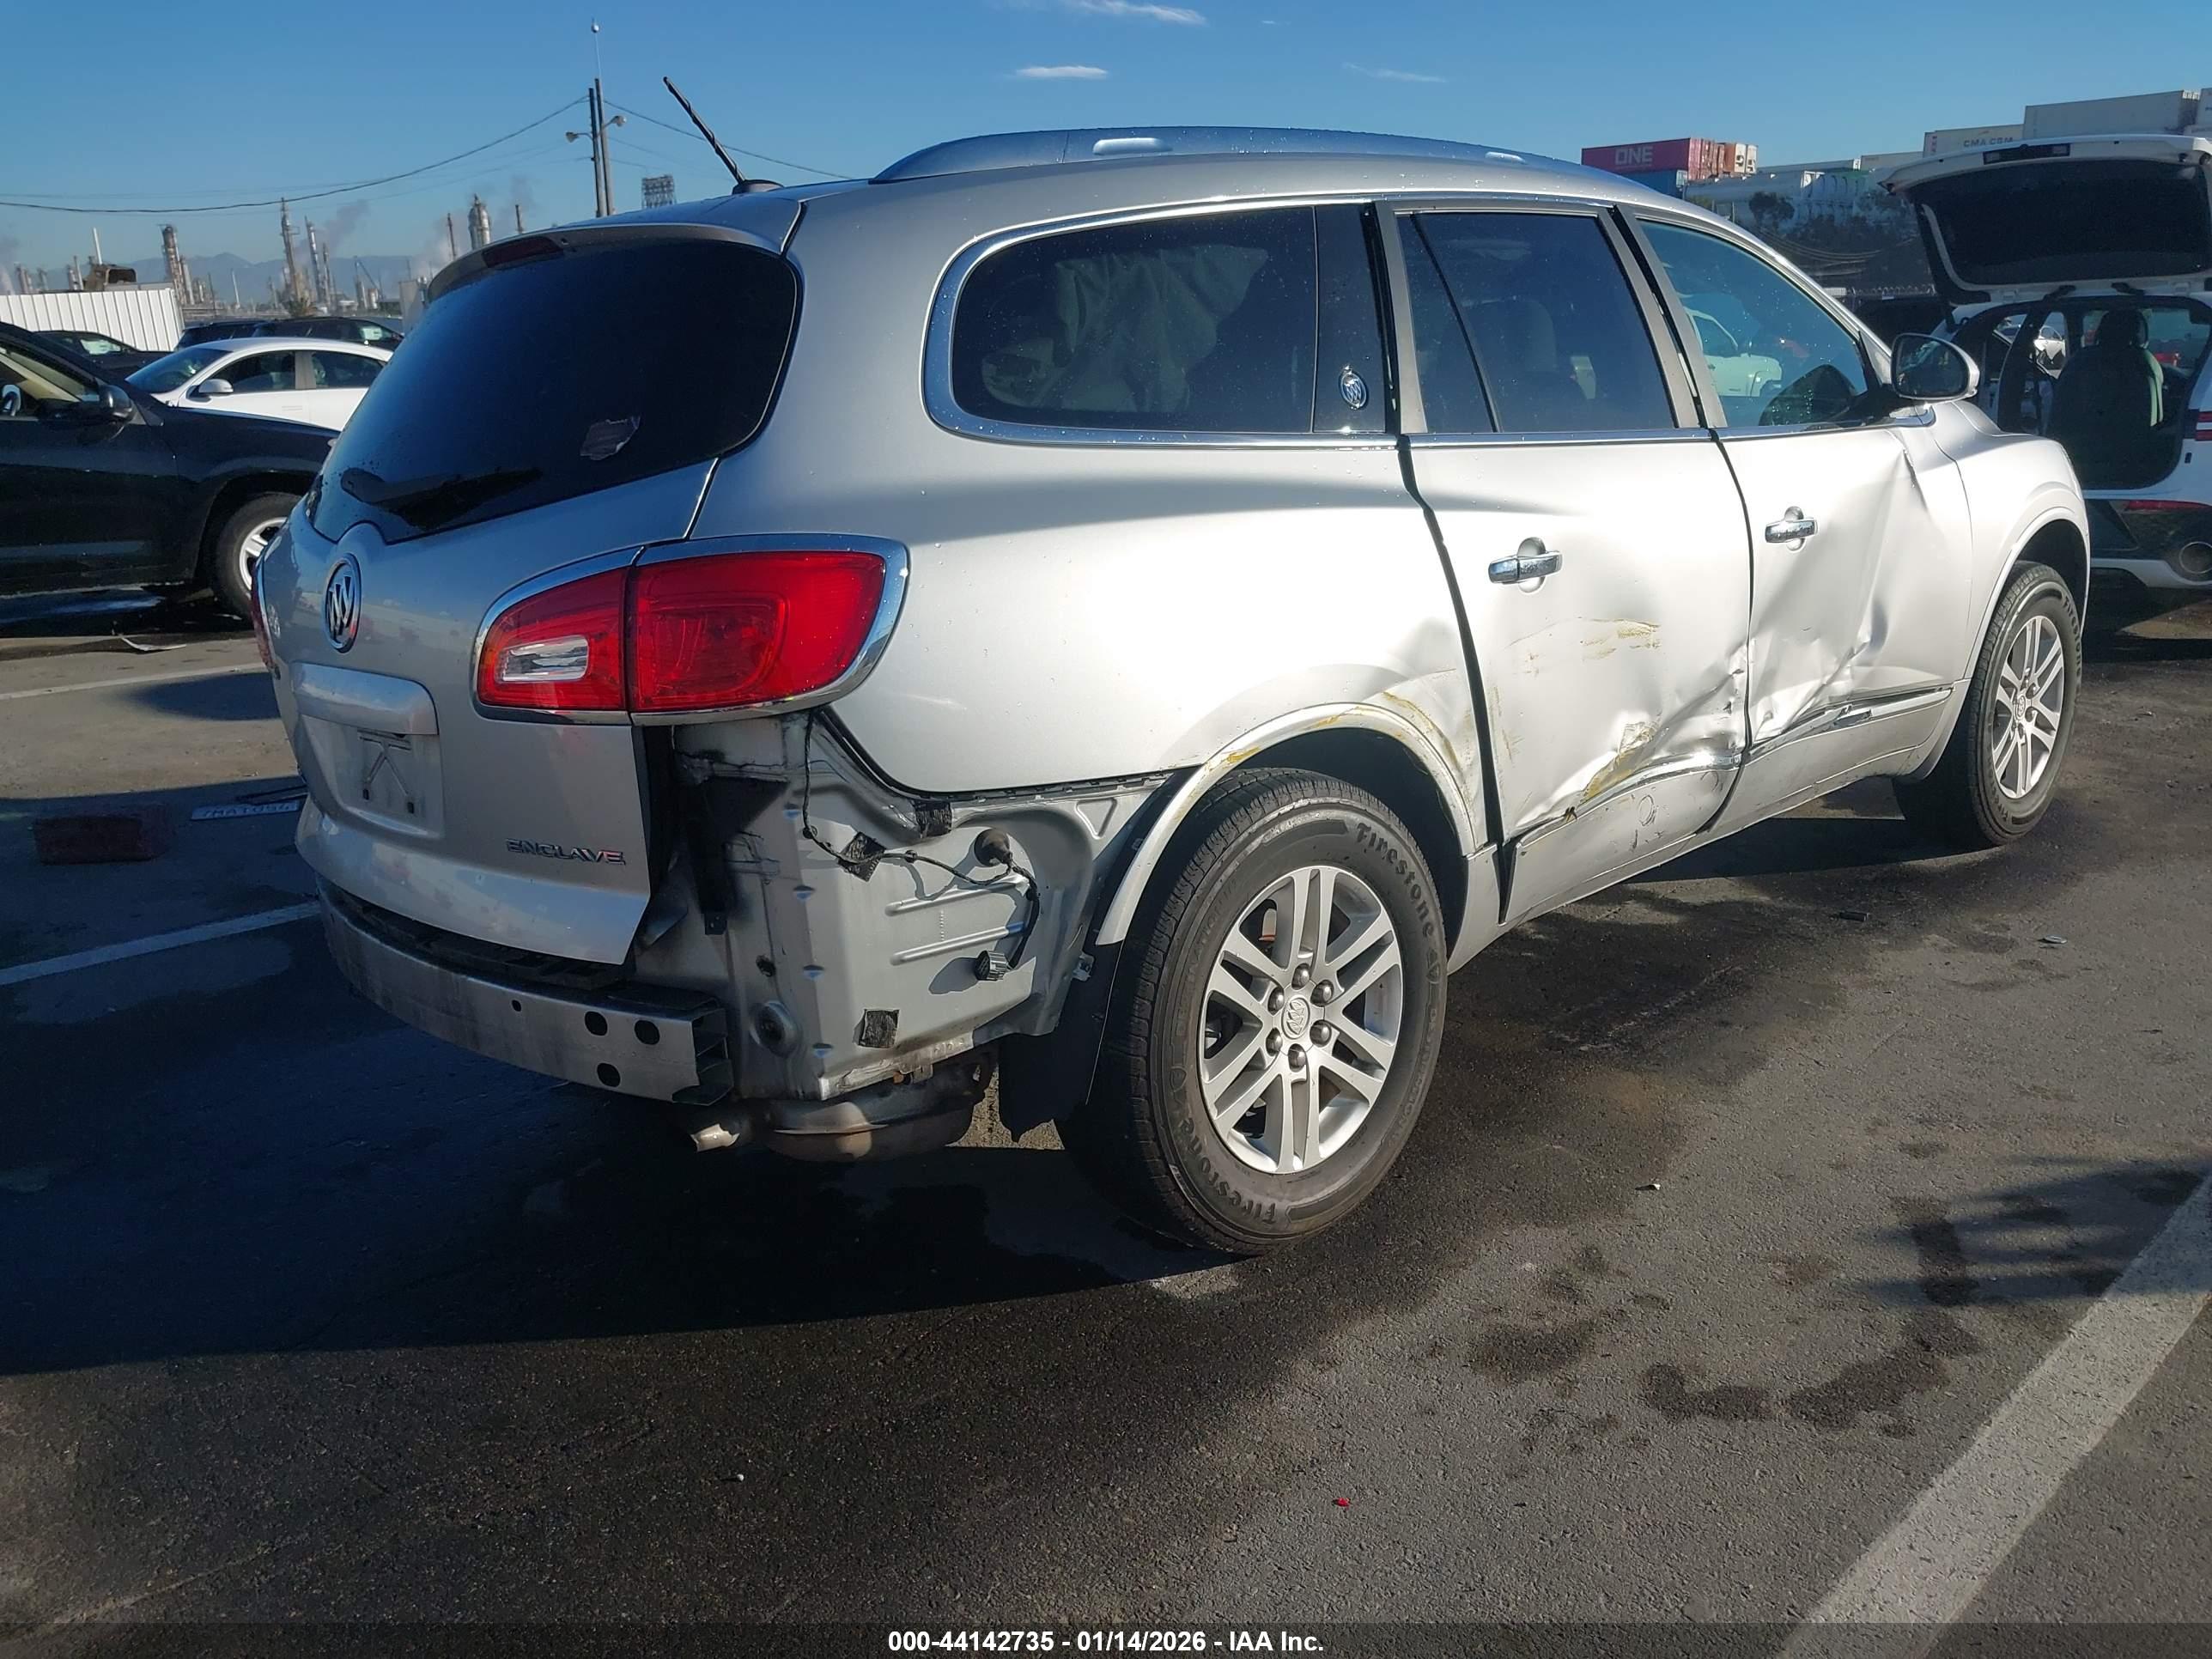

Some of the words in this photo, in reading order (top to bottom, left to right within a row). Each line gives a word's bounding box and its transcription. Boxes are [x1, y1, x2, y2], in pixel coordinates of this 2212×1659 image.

[1614, 145, 1654, 166] ONE
[1963, 138, 1986, 148] CMA
[505, 837, 627, 866] ENCLAVE
[1356, 822, 1435, 939] Firestone
